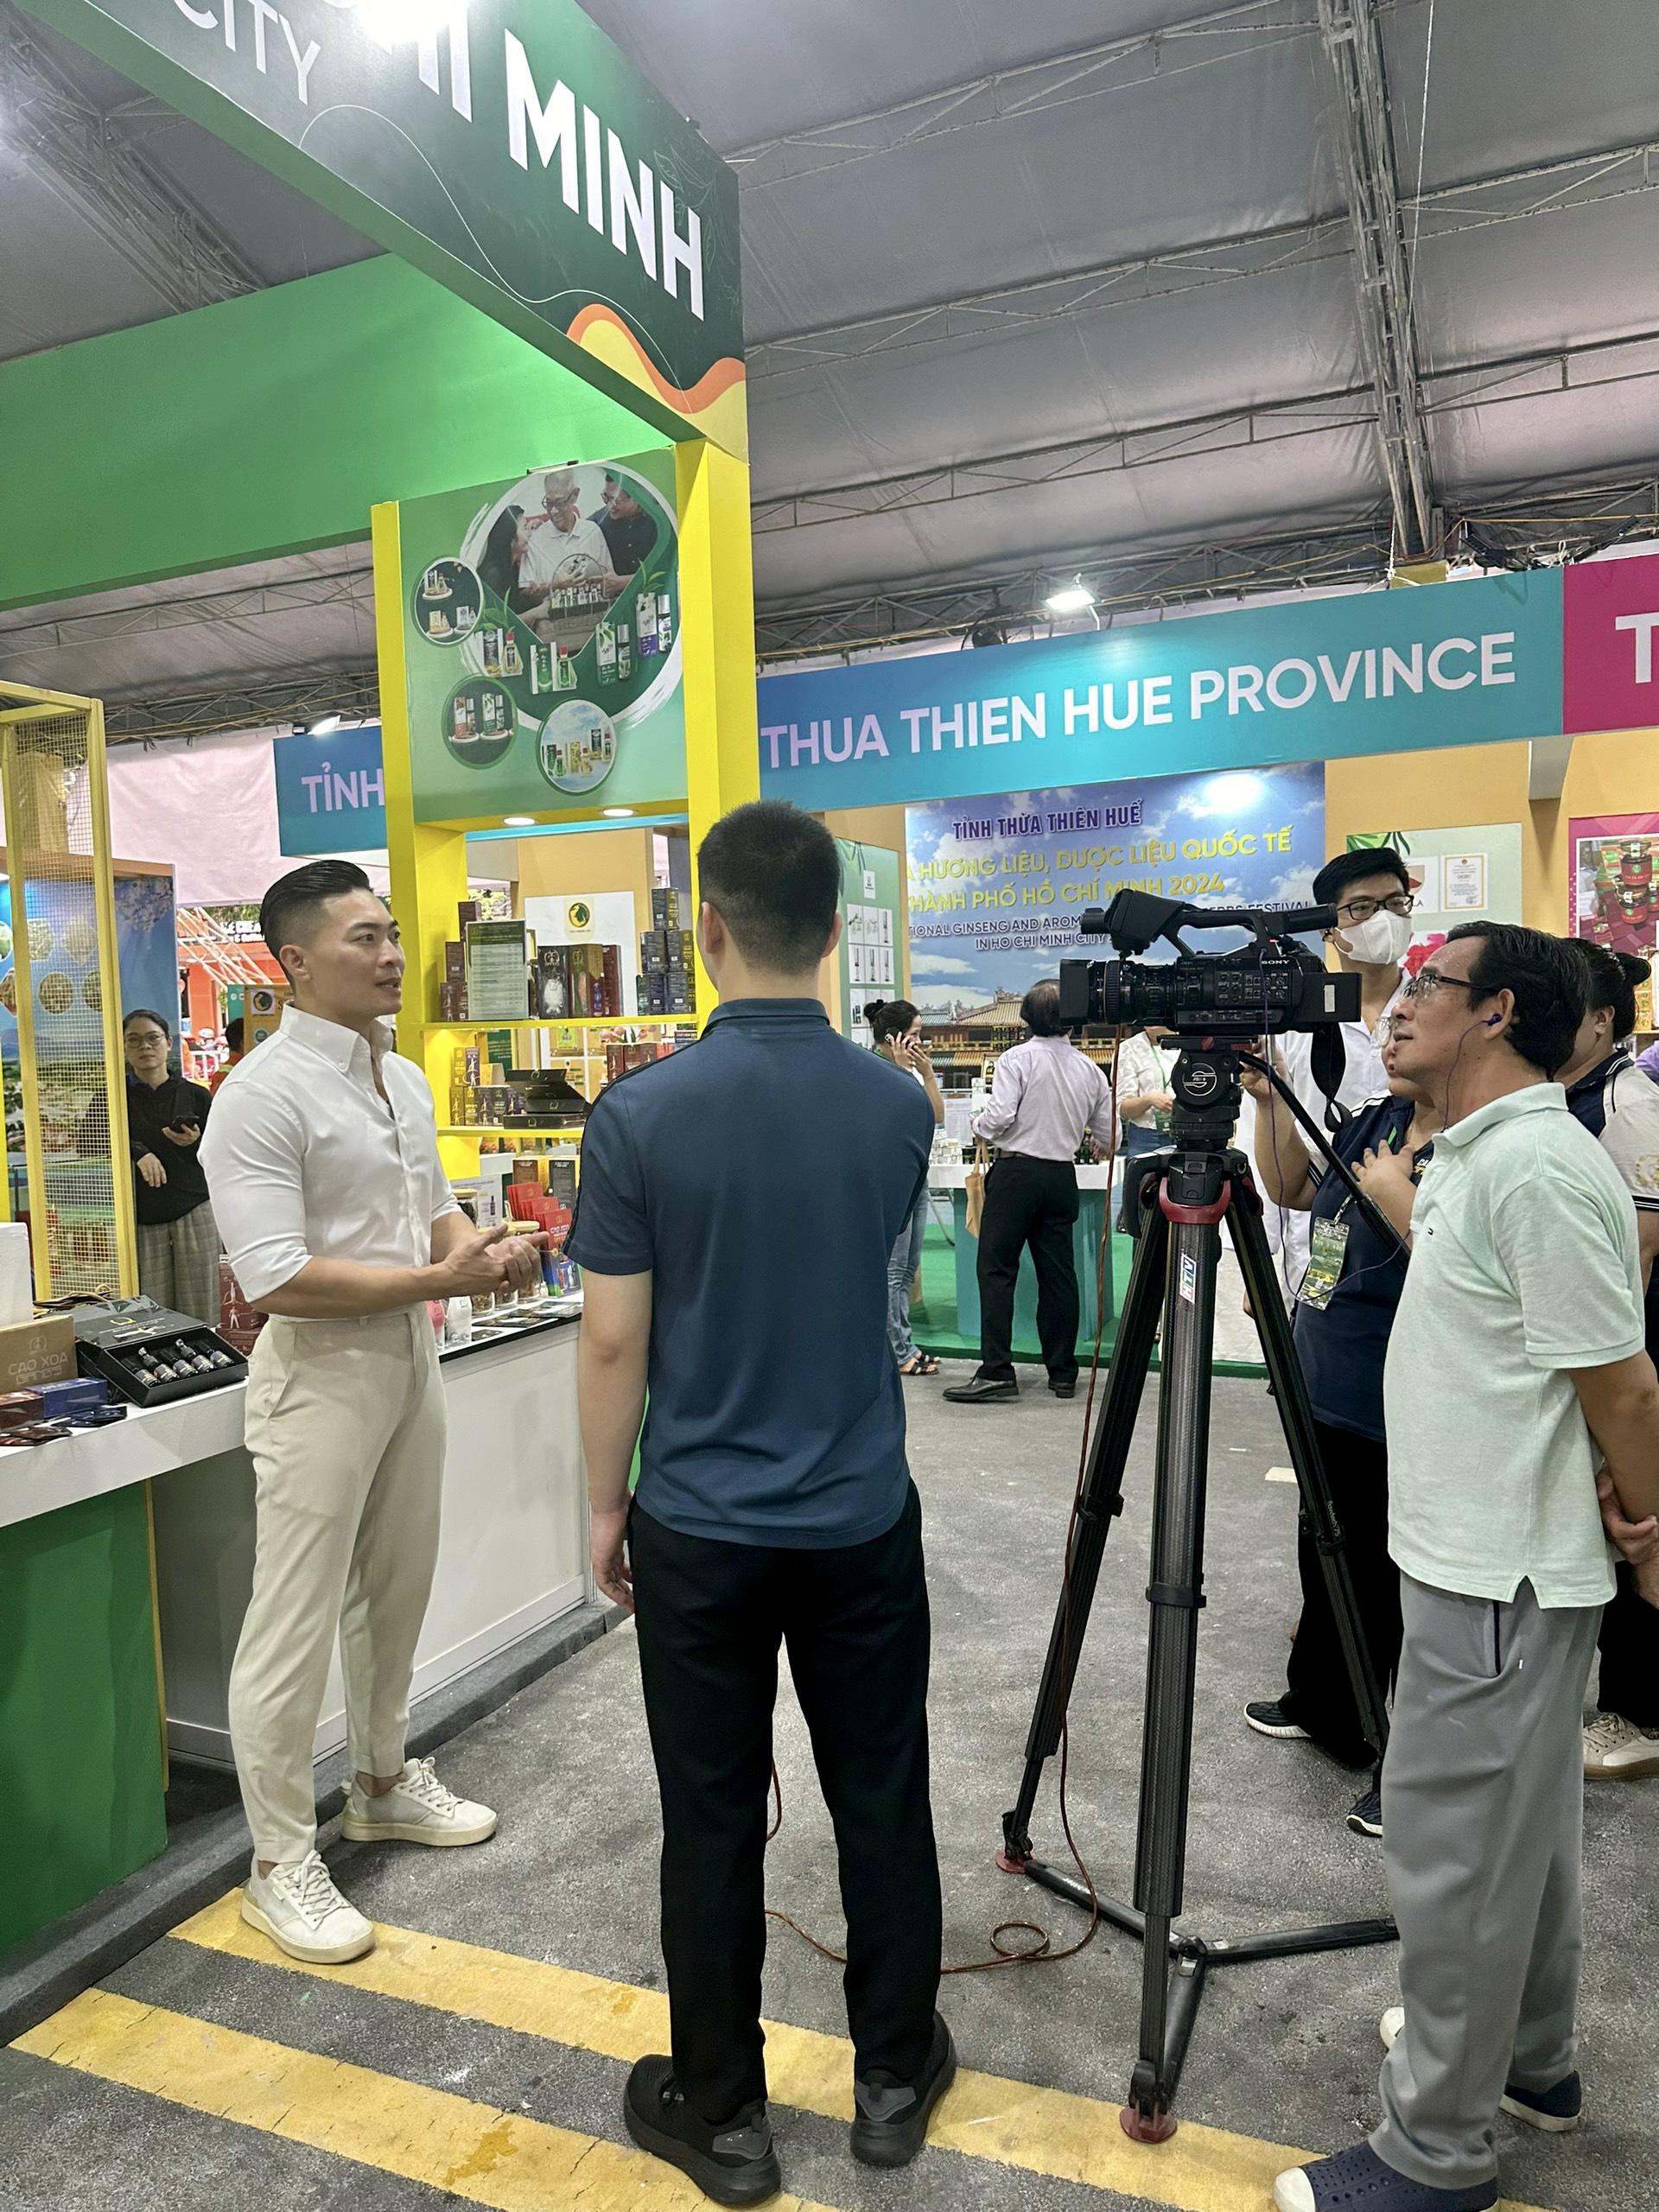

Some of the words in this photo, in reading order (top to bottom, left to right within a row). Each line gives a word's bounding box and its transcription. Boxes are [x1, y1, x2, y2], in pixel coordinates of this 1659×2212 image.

[504, 29, 704, 322] MINH
[760, 714, 890, 768] THUA
[899, 691, 1046, 753] THIEN
[1063, 676, 1173, 736] HUE
[1189, 632, 1516, 720] PROVINCE
[301, 760, 385, 813] TỈNH
[952, 815, 992, 840] TỈNH
[997, 812, 1041, 836] THỪA
[1047, 806, 1099, 832] THIÊN
[1105, 798, 1142, 827] HUẾ
[919, 855, 995, 880] HƯƠNG
[1128, 838, 1177, 868] LIỆU
[1182, 829, 1258, 860] QUỐC
[1262, 823, 1294, 853] TẾ
[908, 887, 966, 913] HÀNH
[971, 881, 1018, 909] PHỐ
[1022, 880, 1058, 906] HỒ
[1060, 876, 1101, 902] CHÍ
[1168, 873, 1226, 896] 2024
[952, 919, 1009, 935] GINSENG
[1011, 918, 1039, 931] AND
[1042, 916, 1082, 929] AROM
[976, 938, 988, 949] IN
[991, 938, 1009, 948] HO
[1014, 936, 1036, 947] CHI
[1039, 934, 1072, 946] MINH
[1076, 932, 1106, 944] CITY
[1182, 1255, 1196, 1300] HTV
[8, 1358, 37, 1376] CAO
[41, 1351, 68, 1369] XOA
